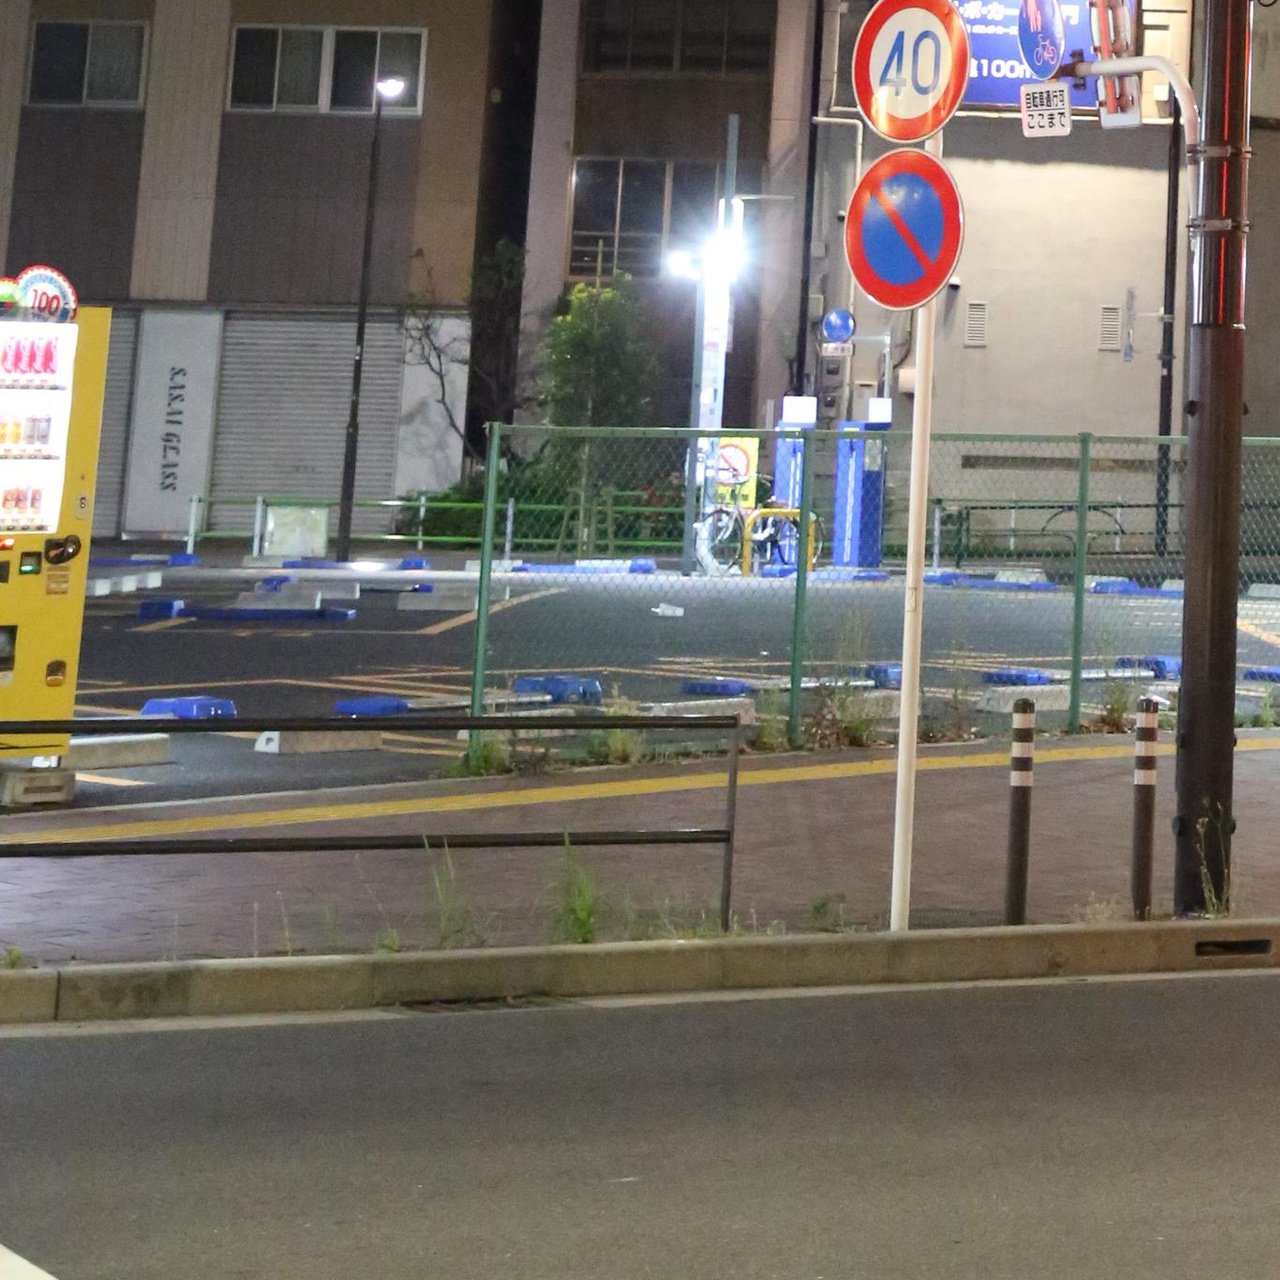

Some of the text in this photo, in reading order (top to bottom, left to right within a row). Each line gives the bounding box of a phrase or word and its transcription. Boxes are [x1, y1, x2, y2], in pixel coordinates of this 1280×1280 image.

[878, 30, 942, 96] 40
[1027, 111, 1066, 129] ここまで
[31, 289, 61, 317] 100
